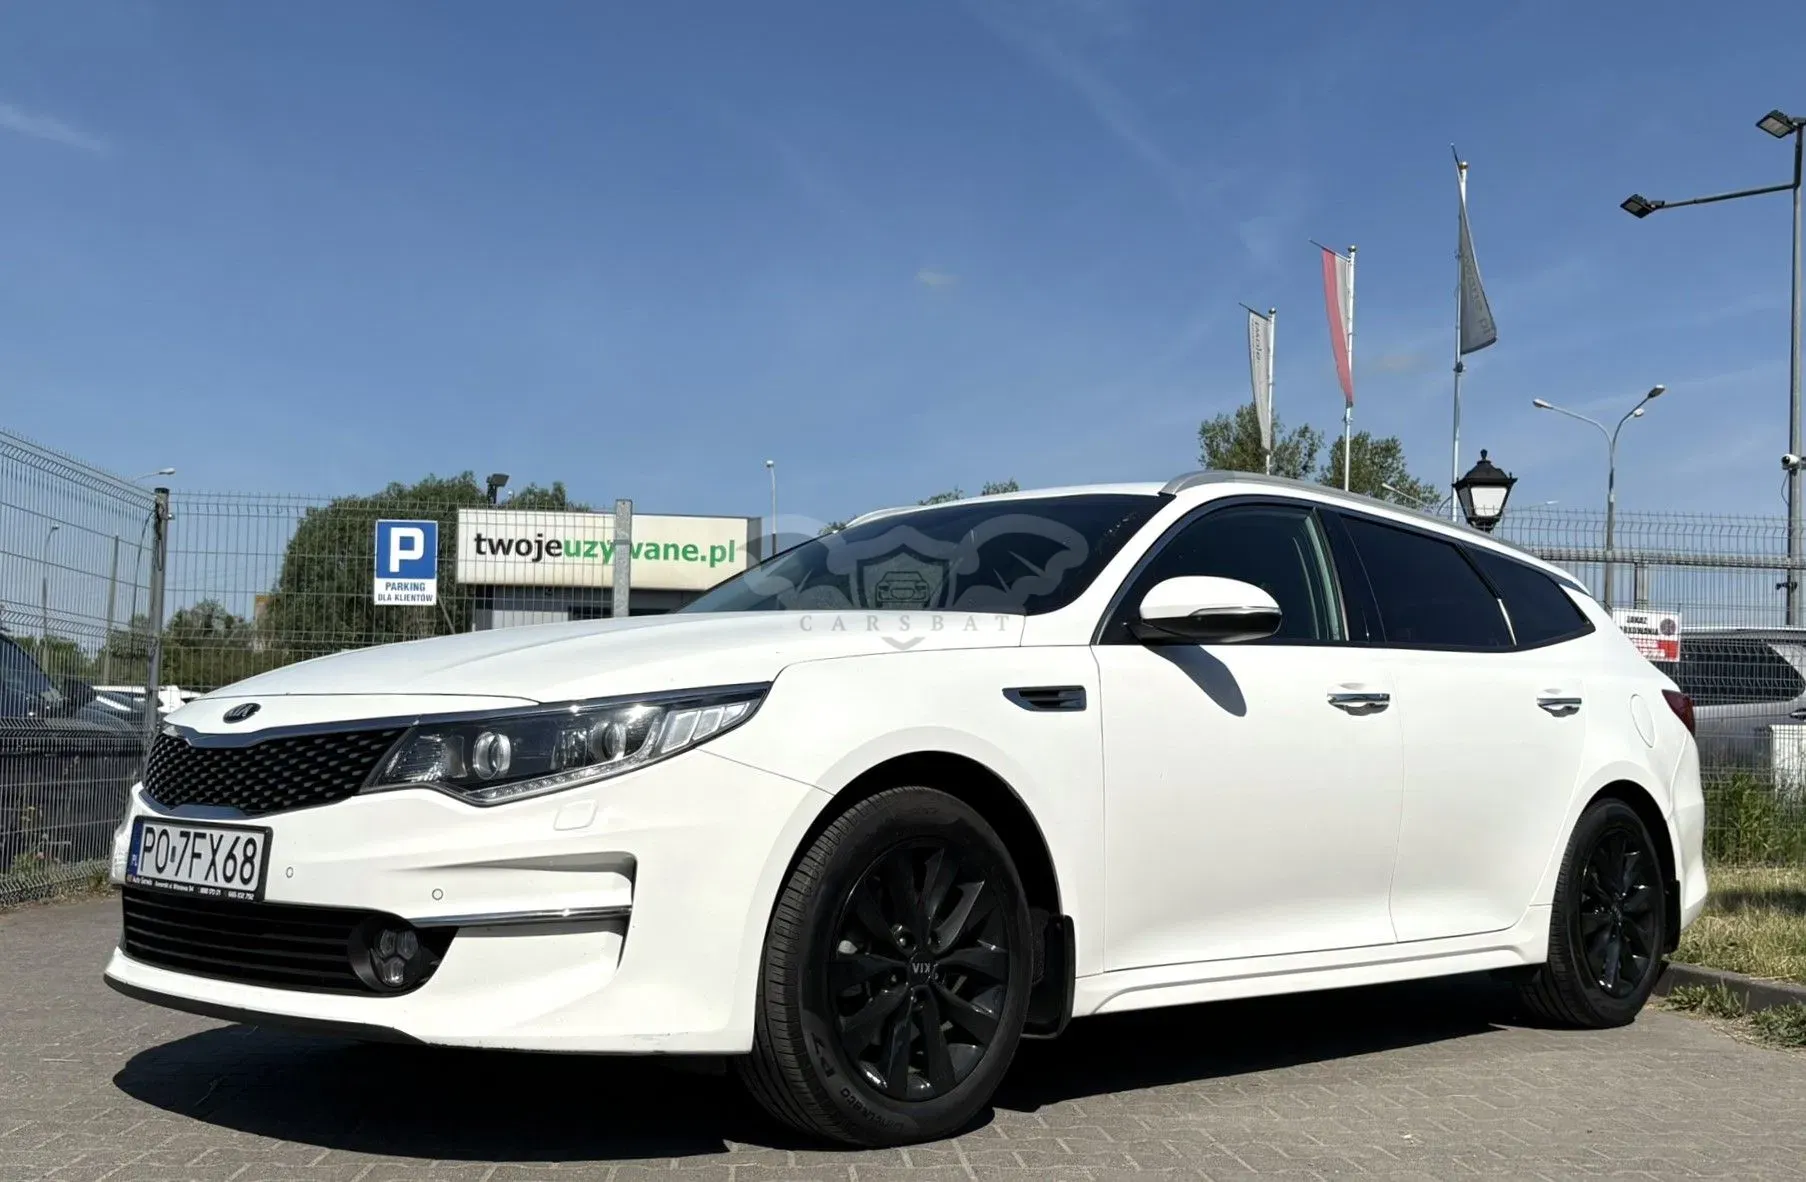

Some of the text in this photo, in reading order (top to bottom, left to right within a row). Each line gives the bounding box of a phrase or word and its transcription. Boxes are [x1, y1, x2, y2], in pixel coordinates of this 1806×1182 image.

[389, 527, 424, 573] P
[385, 582, 426, 592] PARKING
[378, 593, 392, 602] DLA
[140, 826, 258, 886] PO 7FX68
[911, 962, 931, 974] KIA
